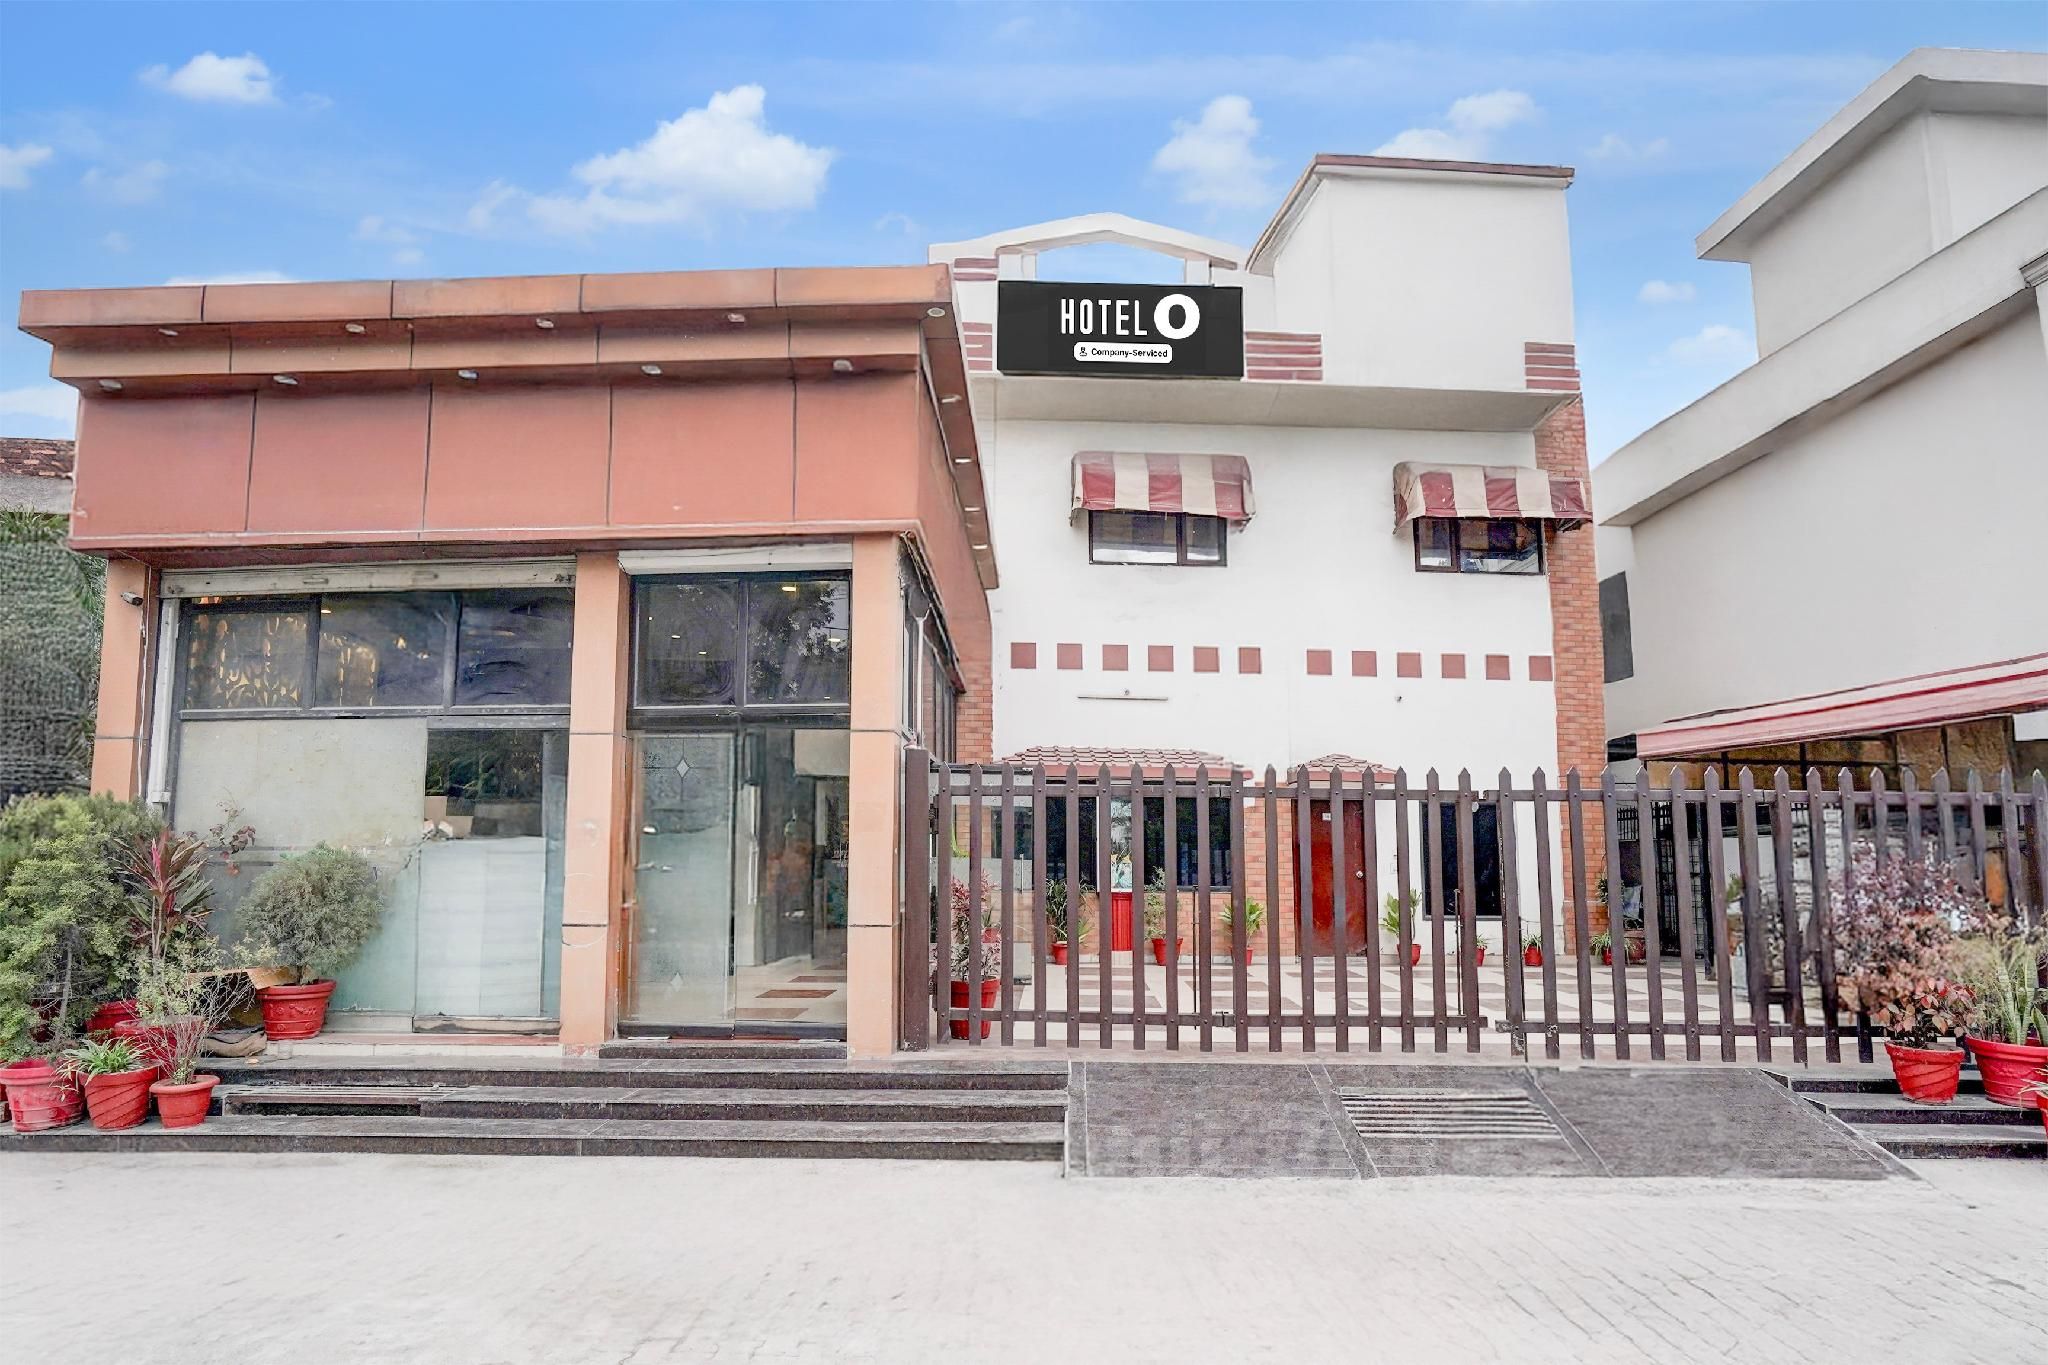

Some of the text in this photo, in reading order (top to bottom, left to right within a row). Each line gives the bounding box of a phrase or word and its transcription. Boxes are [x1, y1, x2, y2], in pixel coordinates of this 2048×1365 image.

[1061, 293, 1200, 340] HOTEL O
[1091, 347, 1168, 358] Company-Serviced
